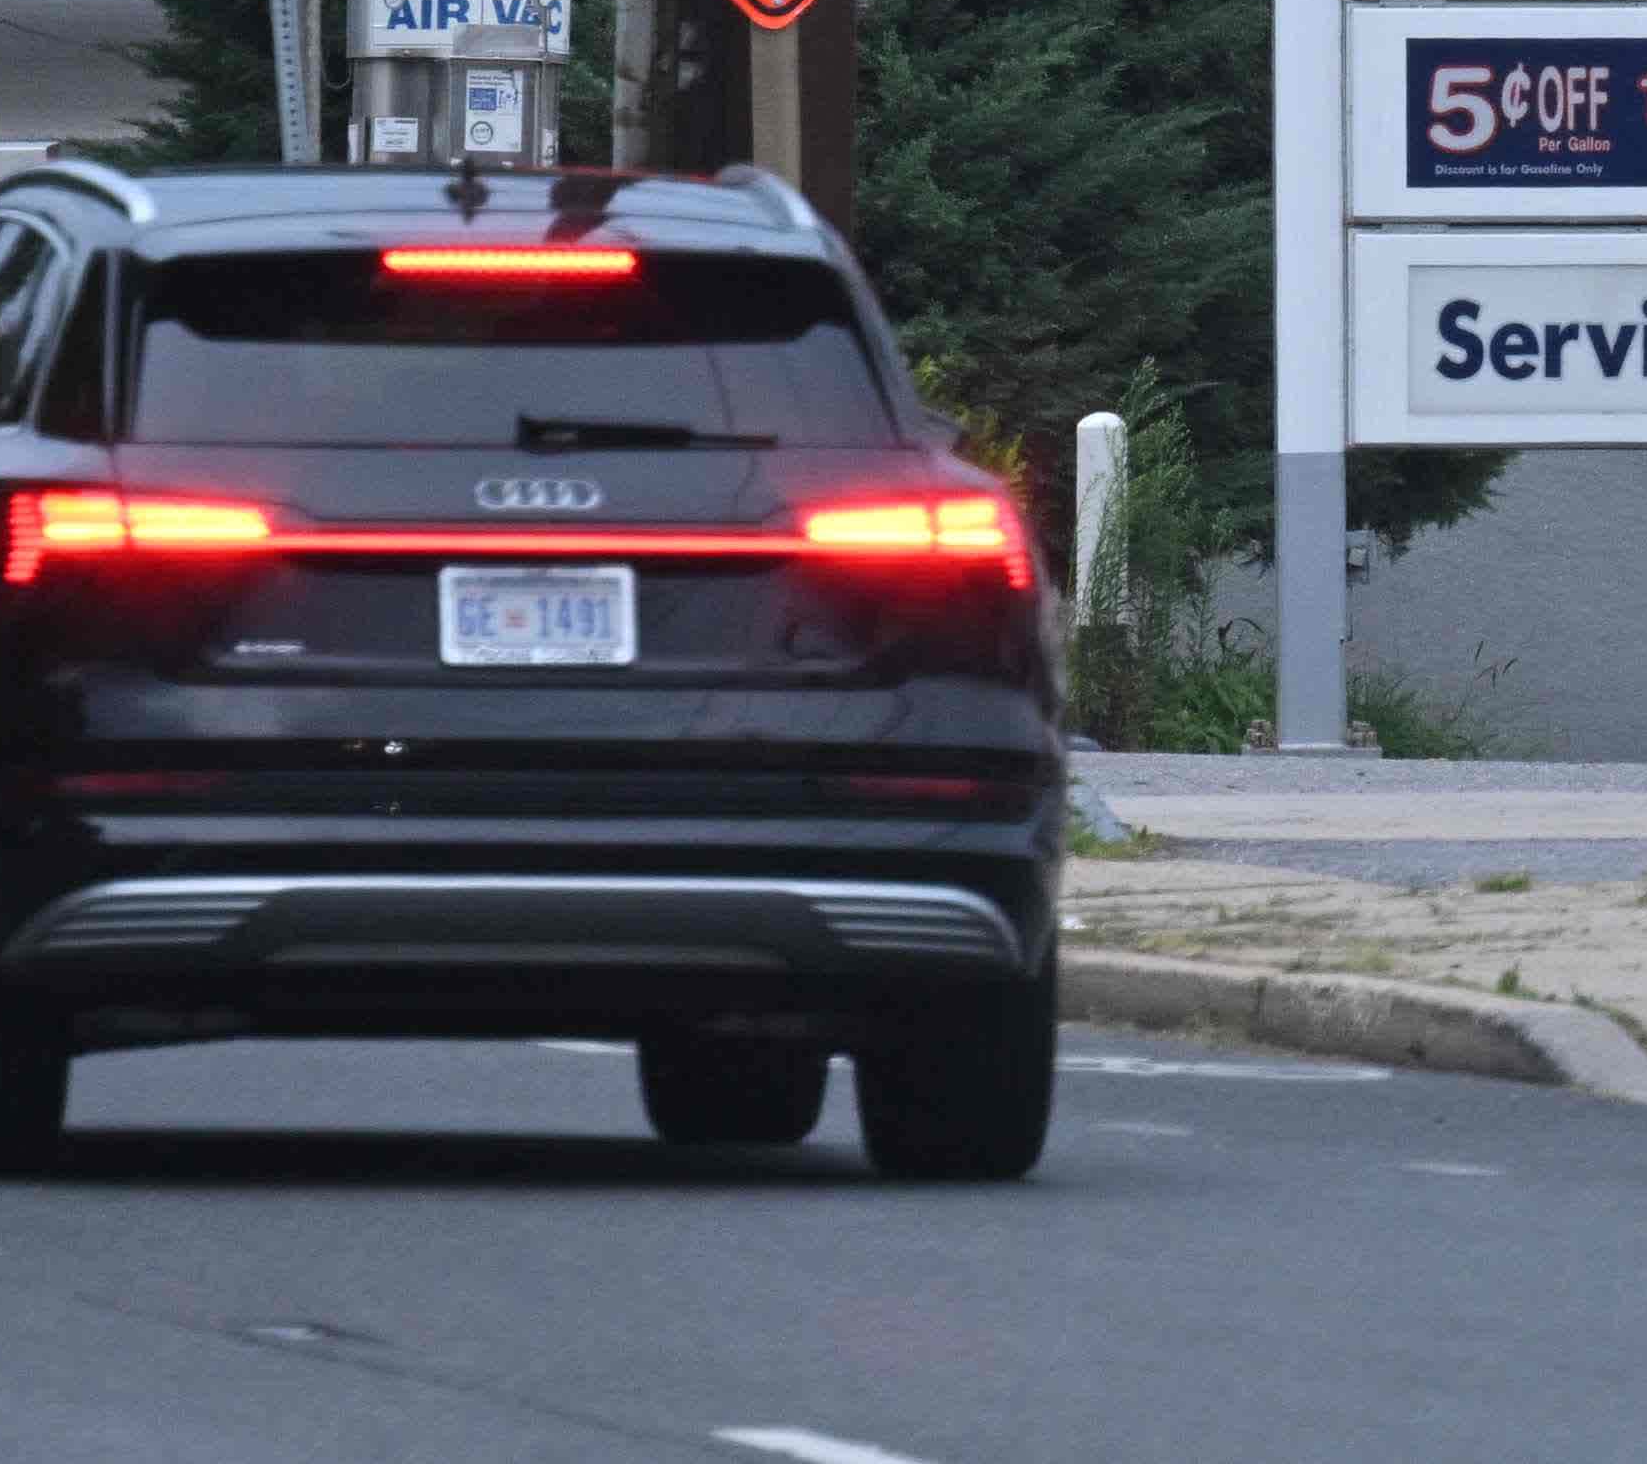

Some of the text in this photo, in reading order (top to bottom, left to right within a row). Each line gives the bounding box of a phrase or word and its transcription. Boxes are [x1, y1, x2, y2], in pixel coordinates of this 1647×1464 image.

[1537, 65, 1610, 132] OFF
[1539, 136, 1611, 152] Per Gallon
[1434, 163, 1603, 177] Discount is for Gasoline Only
